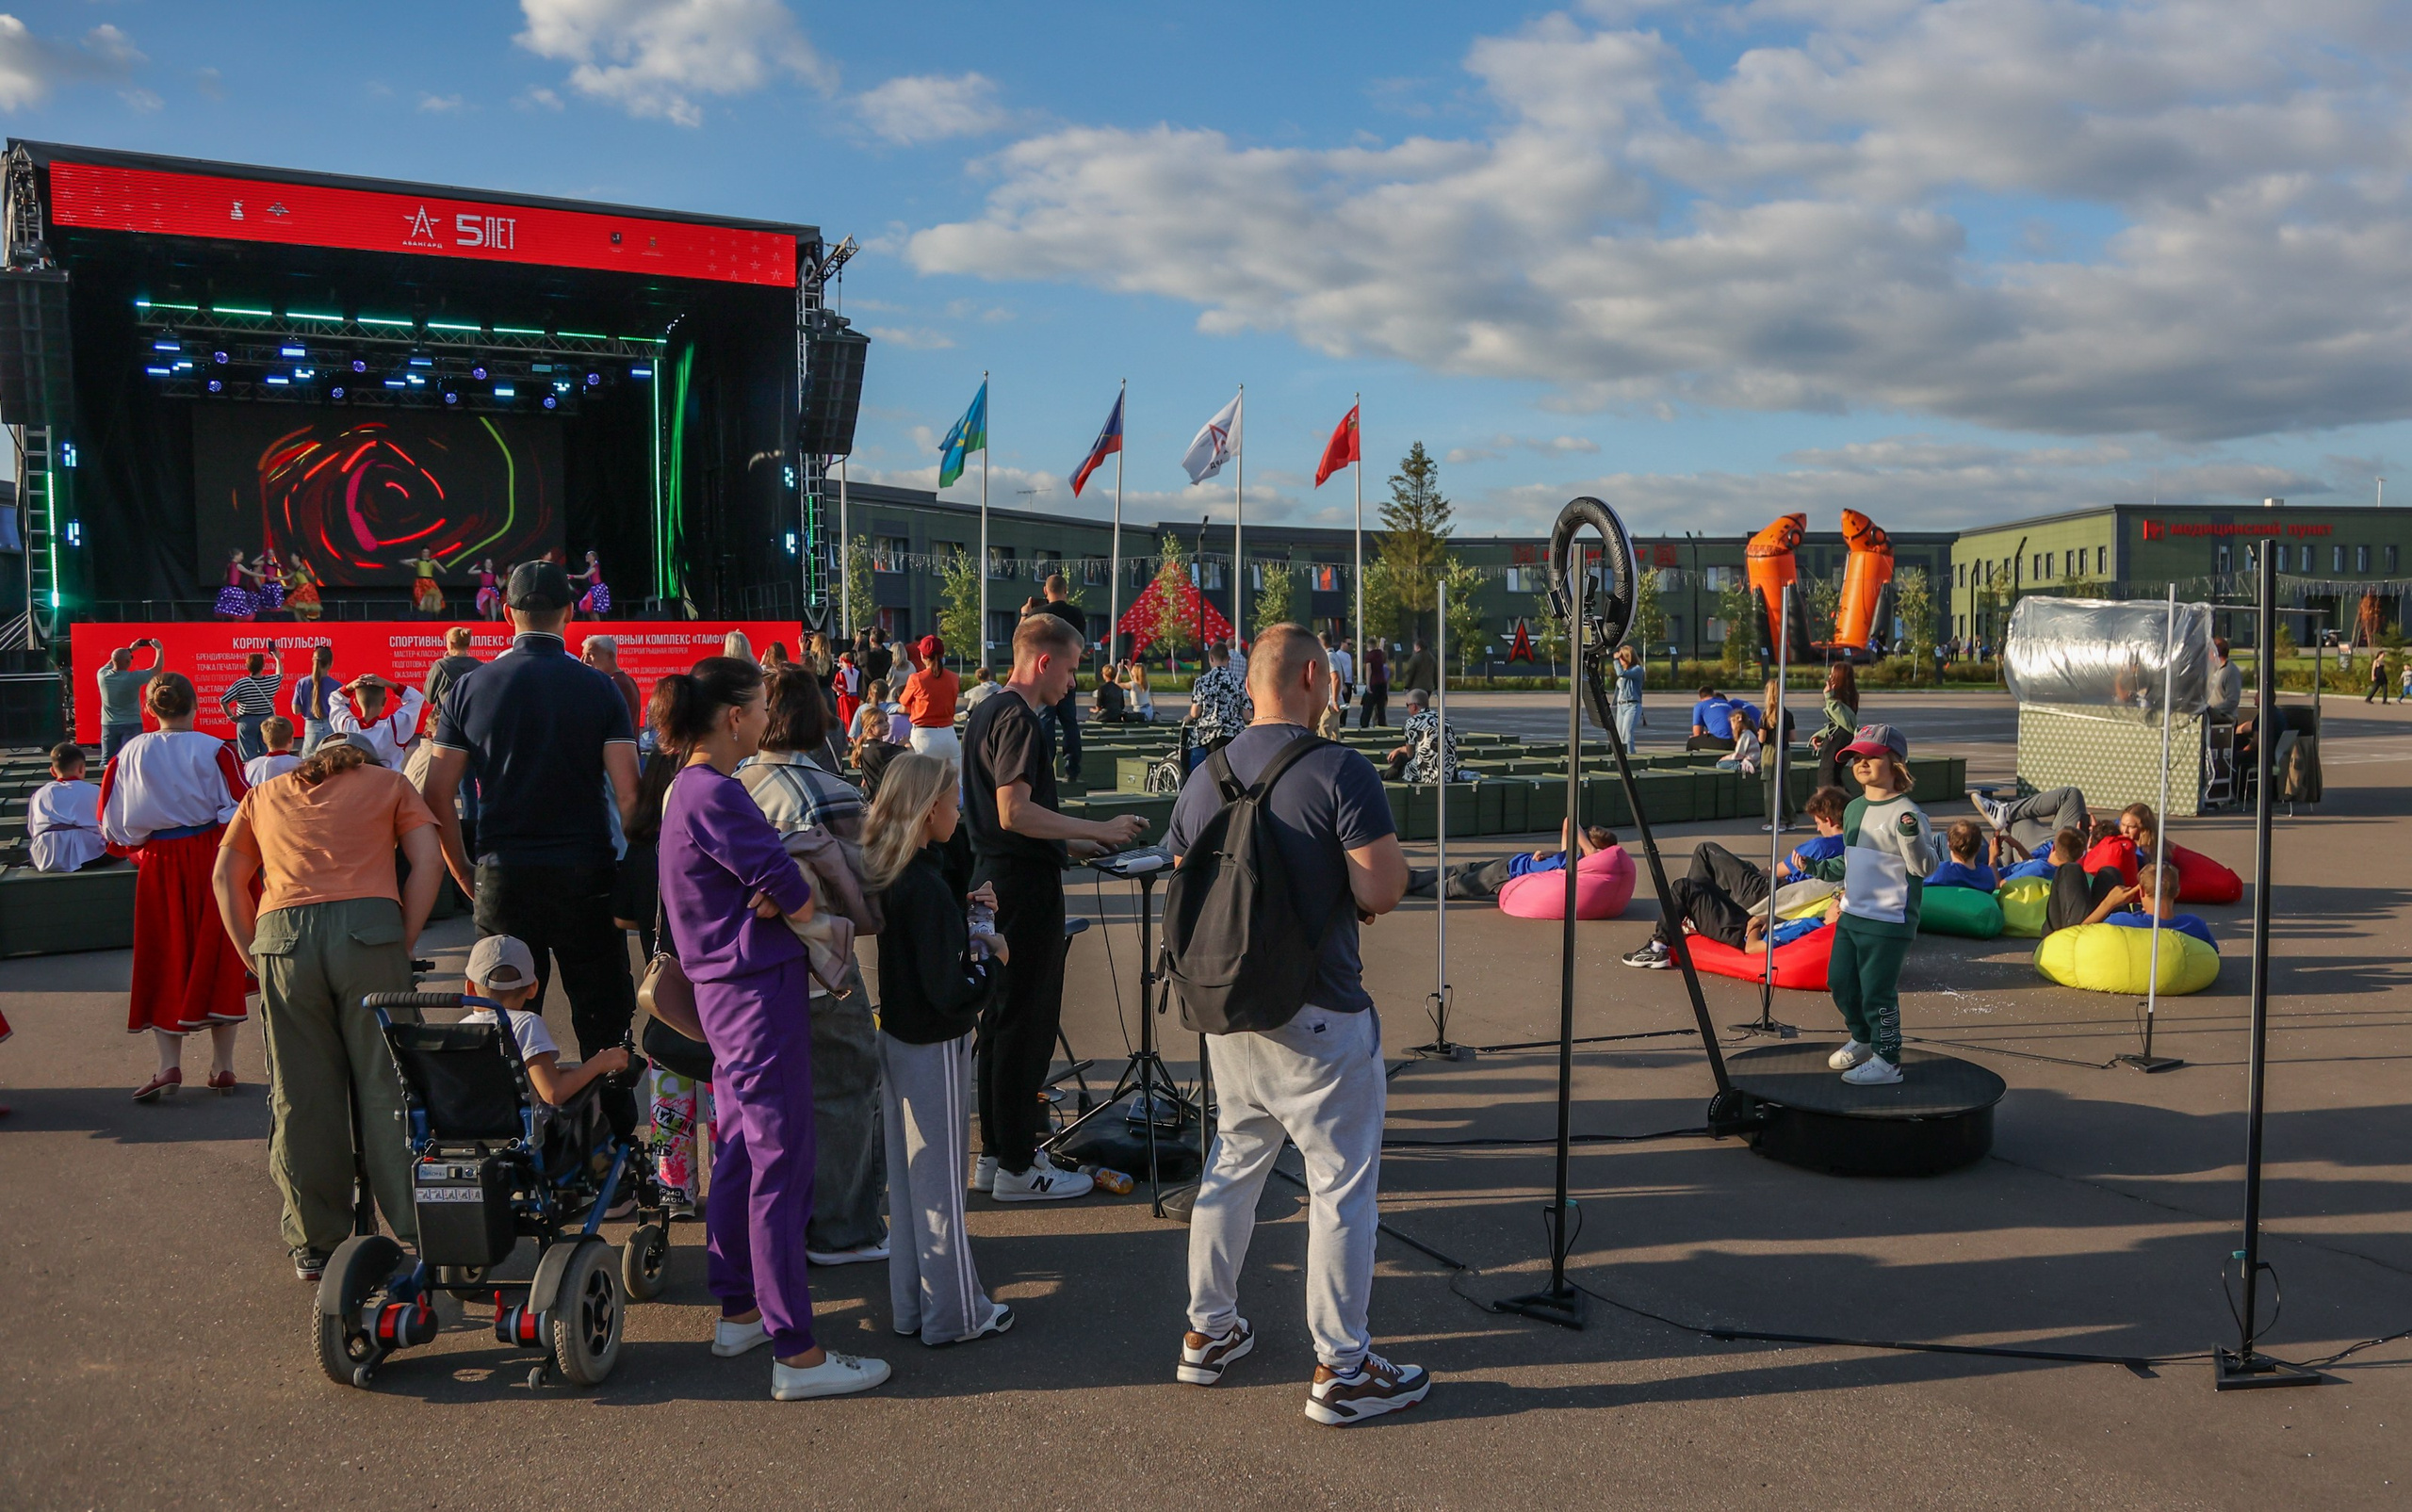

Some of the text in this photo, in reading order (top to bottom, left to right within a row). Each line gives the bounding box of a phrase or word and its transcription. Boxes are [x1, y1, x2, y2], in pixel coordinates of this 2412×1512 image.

[402, 240, 444, 250] АВАНГАРД
[2170, 521, 2333, 539] медицинский пункт
[233, 636, 333, 650] КОРПУС «ПУЛЬСАР»
[389, 635, 446, 647] СПОРТИВНЫ
[469, 635, 504, 647] МПЛЕКС
[645, 634, 691, 645] КОМПЛЕКС
[693, 633, 726, 644] «ТАЙФУ
[196, 662, 216, 672] ТОЧКА
